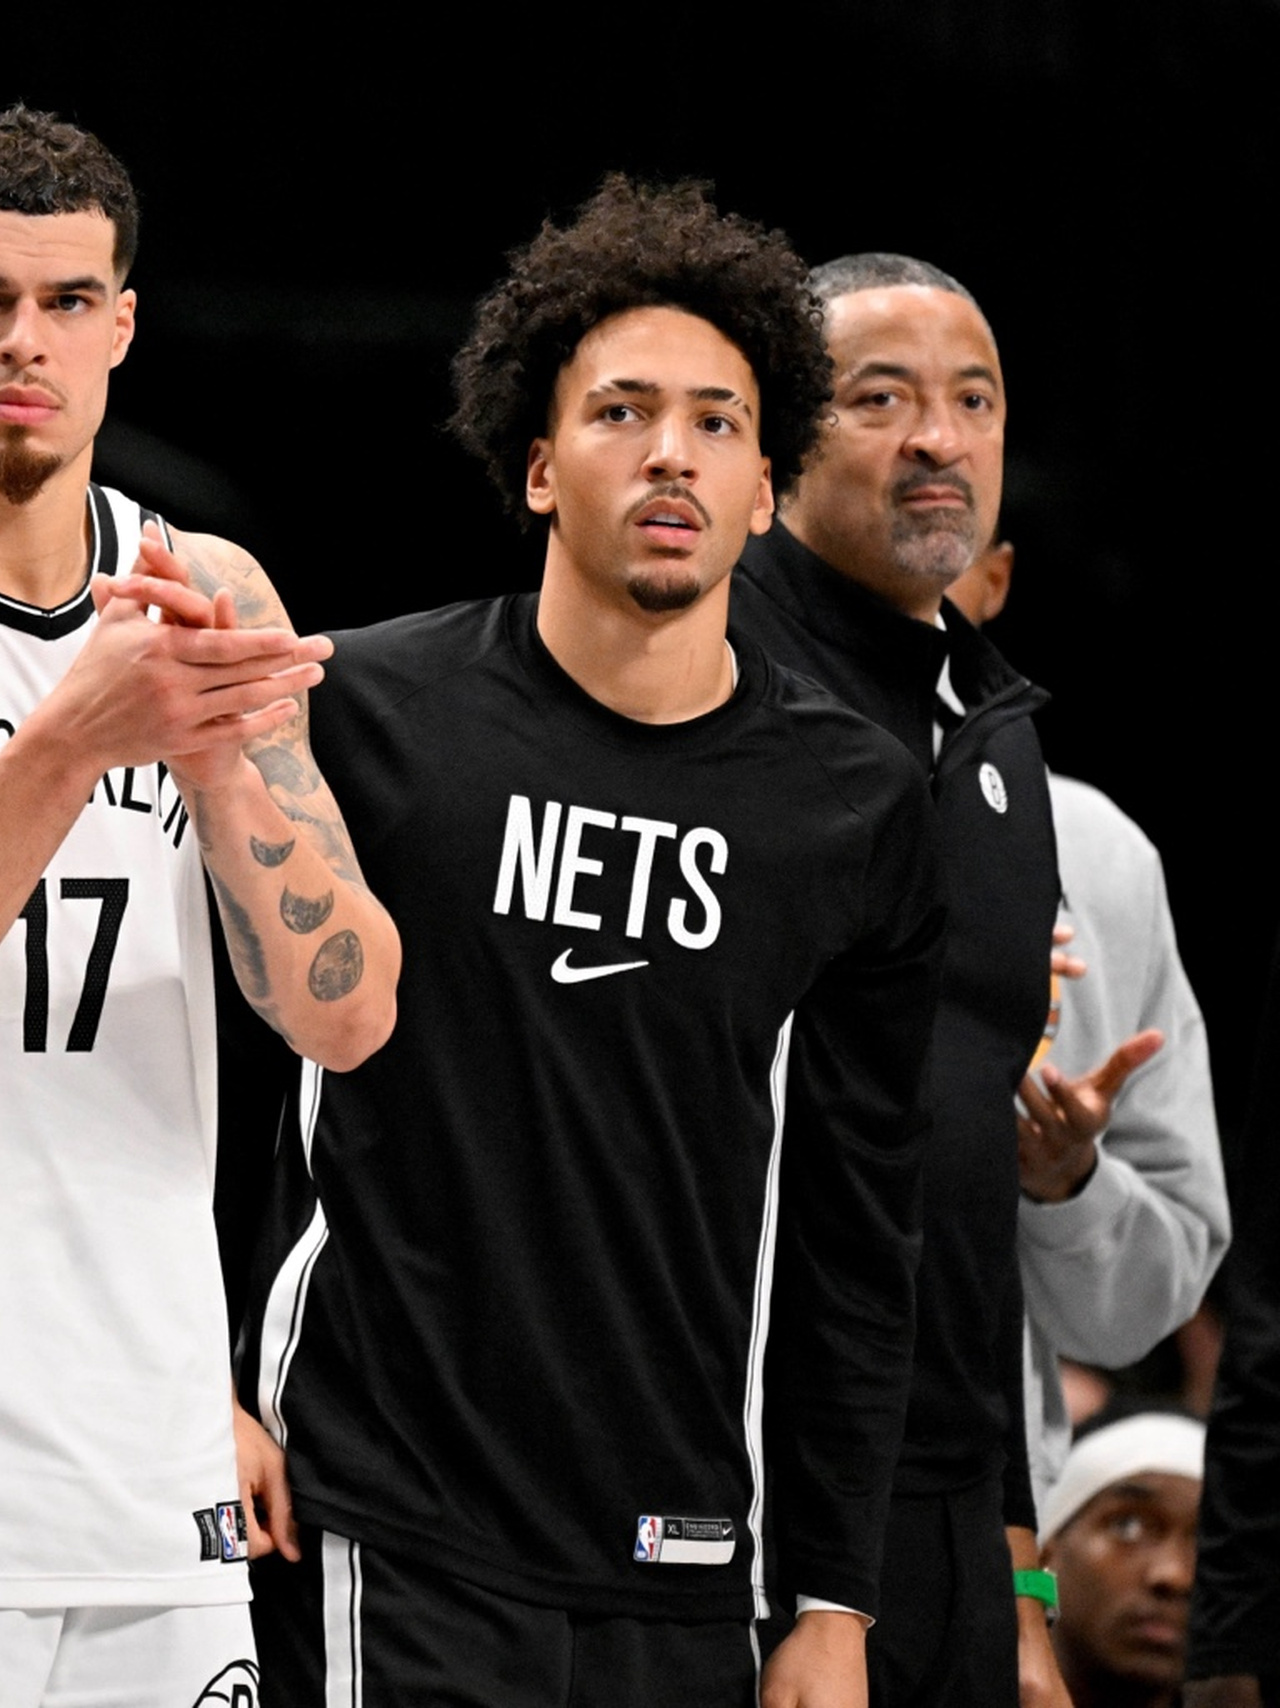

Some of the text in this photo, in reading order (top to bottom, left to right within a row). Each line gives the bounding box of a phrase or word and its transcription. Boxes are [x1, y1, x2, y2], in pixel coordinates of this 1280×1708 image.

[493, 794, 729, 950] NETS
[18, 878, 129, 1053] 17
[667, 1523, 680, 1535] XL
